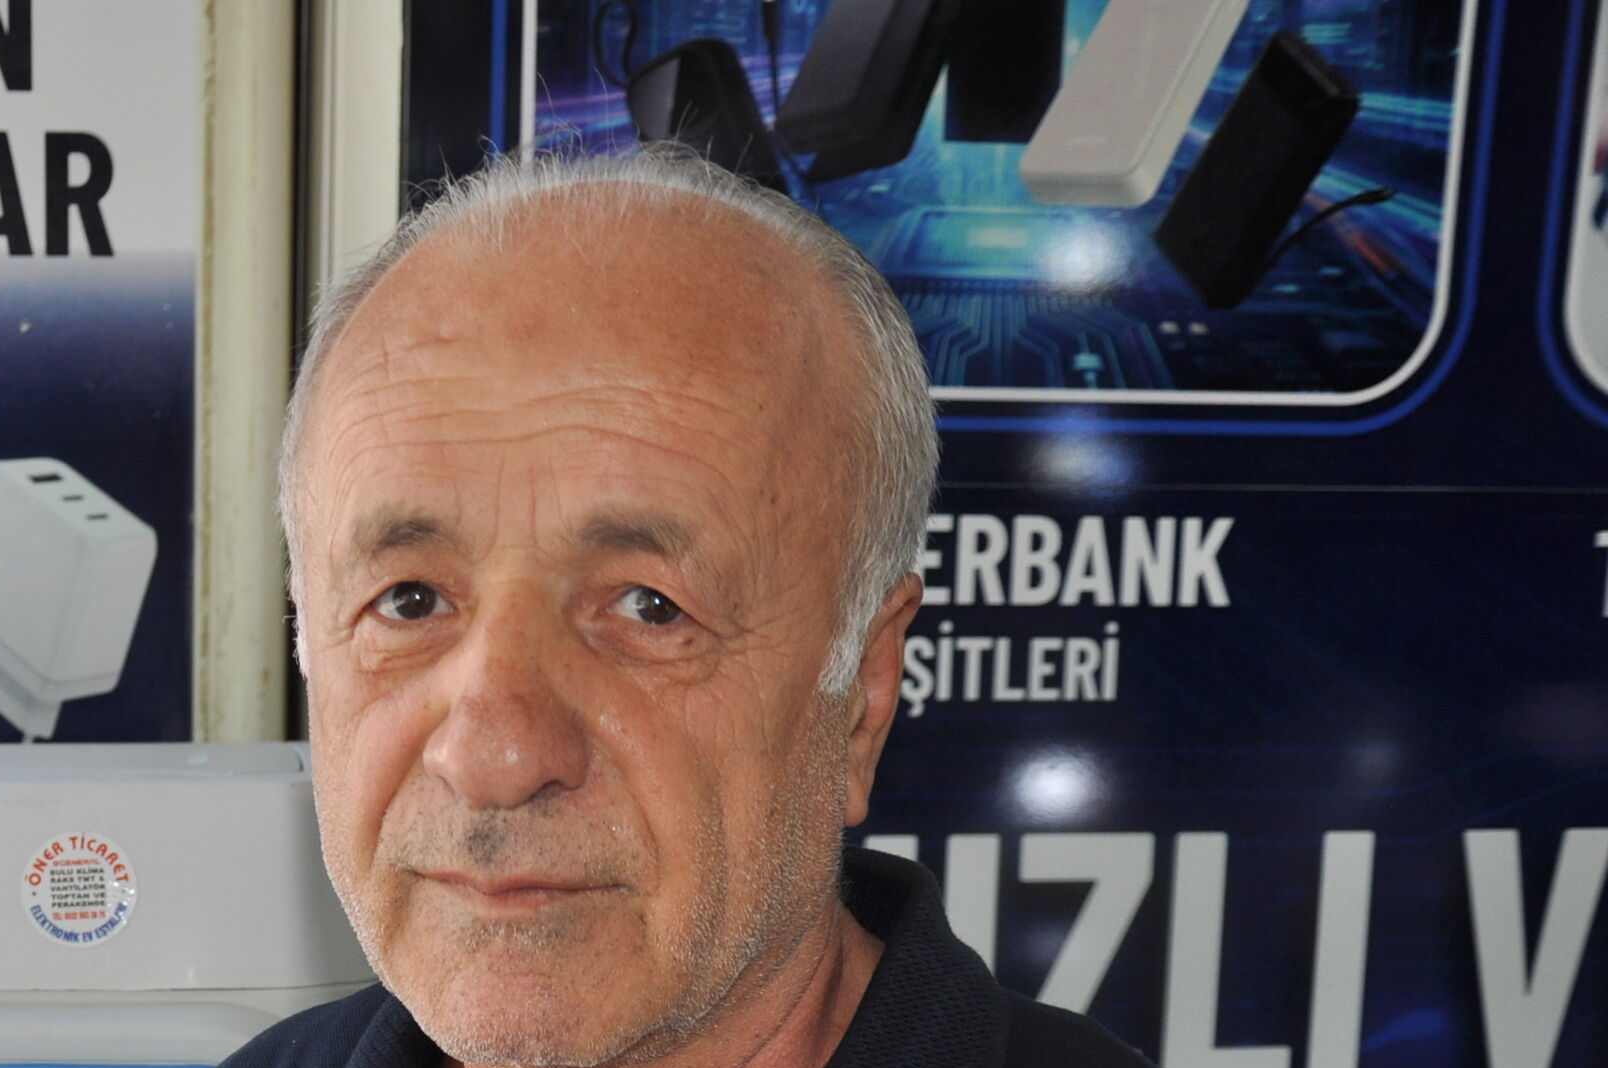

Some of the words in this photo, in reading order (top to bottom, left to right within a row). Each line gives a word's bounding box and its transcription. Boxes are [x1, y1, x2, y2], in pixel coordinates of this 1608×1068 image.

[900, 621, 1120, 716] ŞİTLERİ
[25, 841, 64, 886] ÖNER
[69, 832, 129, 882] TİCARET
[30, 904, 79, 943] ELEKTRONİK
[82, 931, 93, 943] EV
